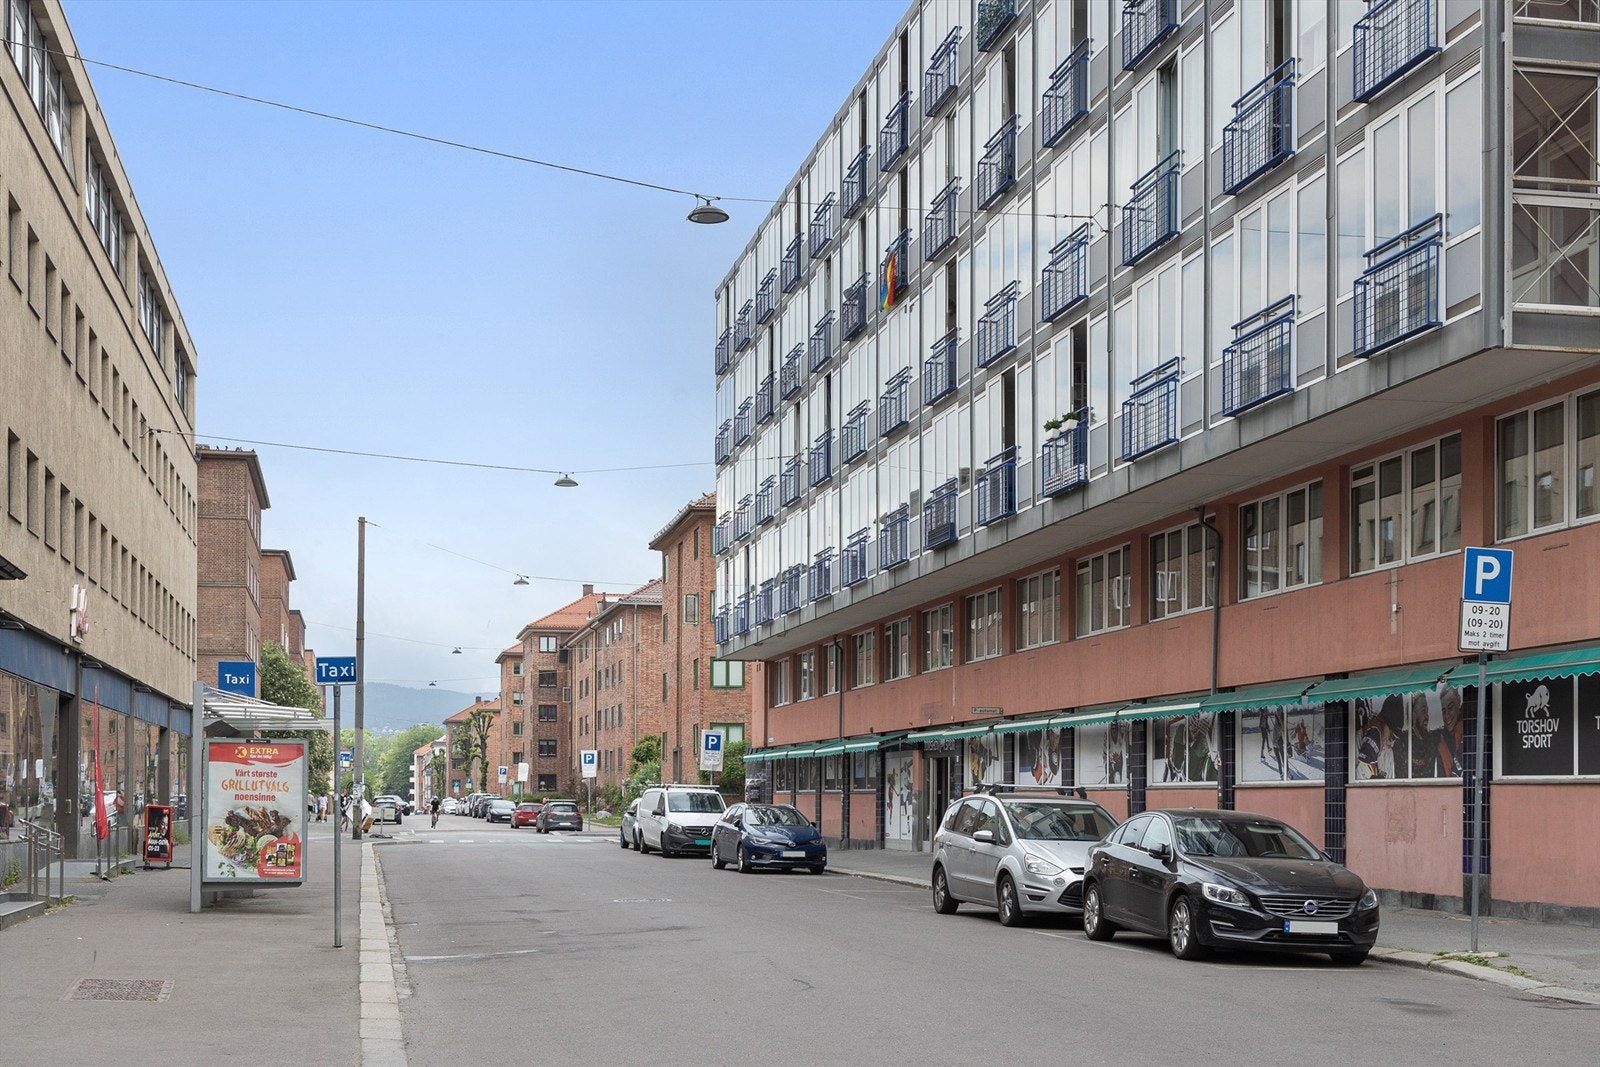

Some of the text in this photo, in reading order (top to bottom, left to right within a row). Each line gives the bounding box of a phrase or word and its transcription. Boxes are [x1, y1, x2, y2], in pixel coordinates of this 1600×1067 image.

[1475, 555, 1501, 595] P
[1472, 605, 1501, 616] 09-20
[1467, 617, 1503, 630] (09-20)
[1468, 639, 1500, 649] mot avgift
[318, 662, 355, 678] Taxi
[224, 673, 250, 685] Taxi
[1516, 718, 1559, 733] TORSHOV
[708, 736, 718, 749] P
[1522, 734, 1553, 748] SPORT
[586, 754, 592, 763] P
[234, 769, 277, 778] Vårt største
[221, 779, 289, 792] GRILLUTVALG
[234, 793, 276, 801] noensinne
